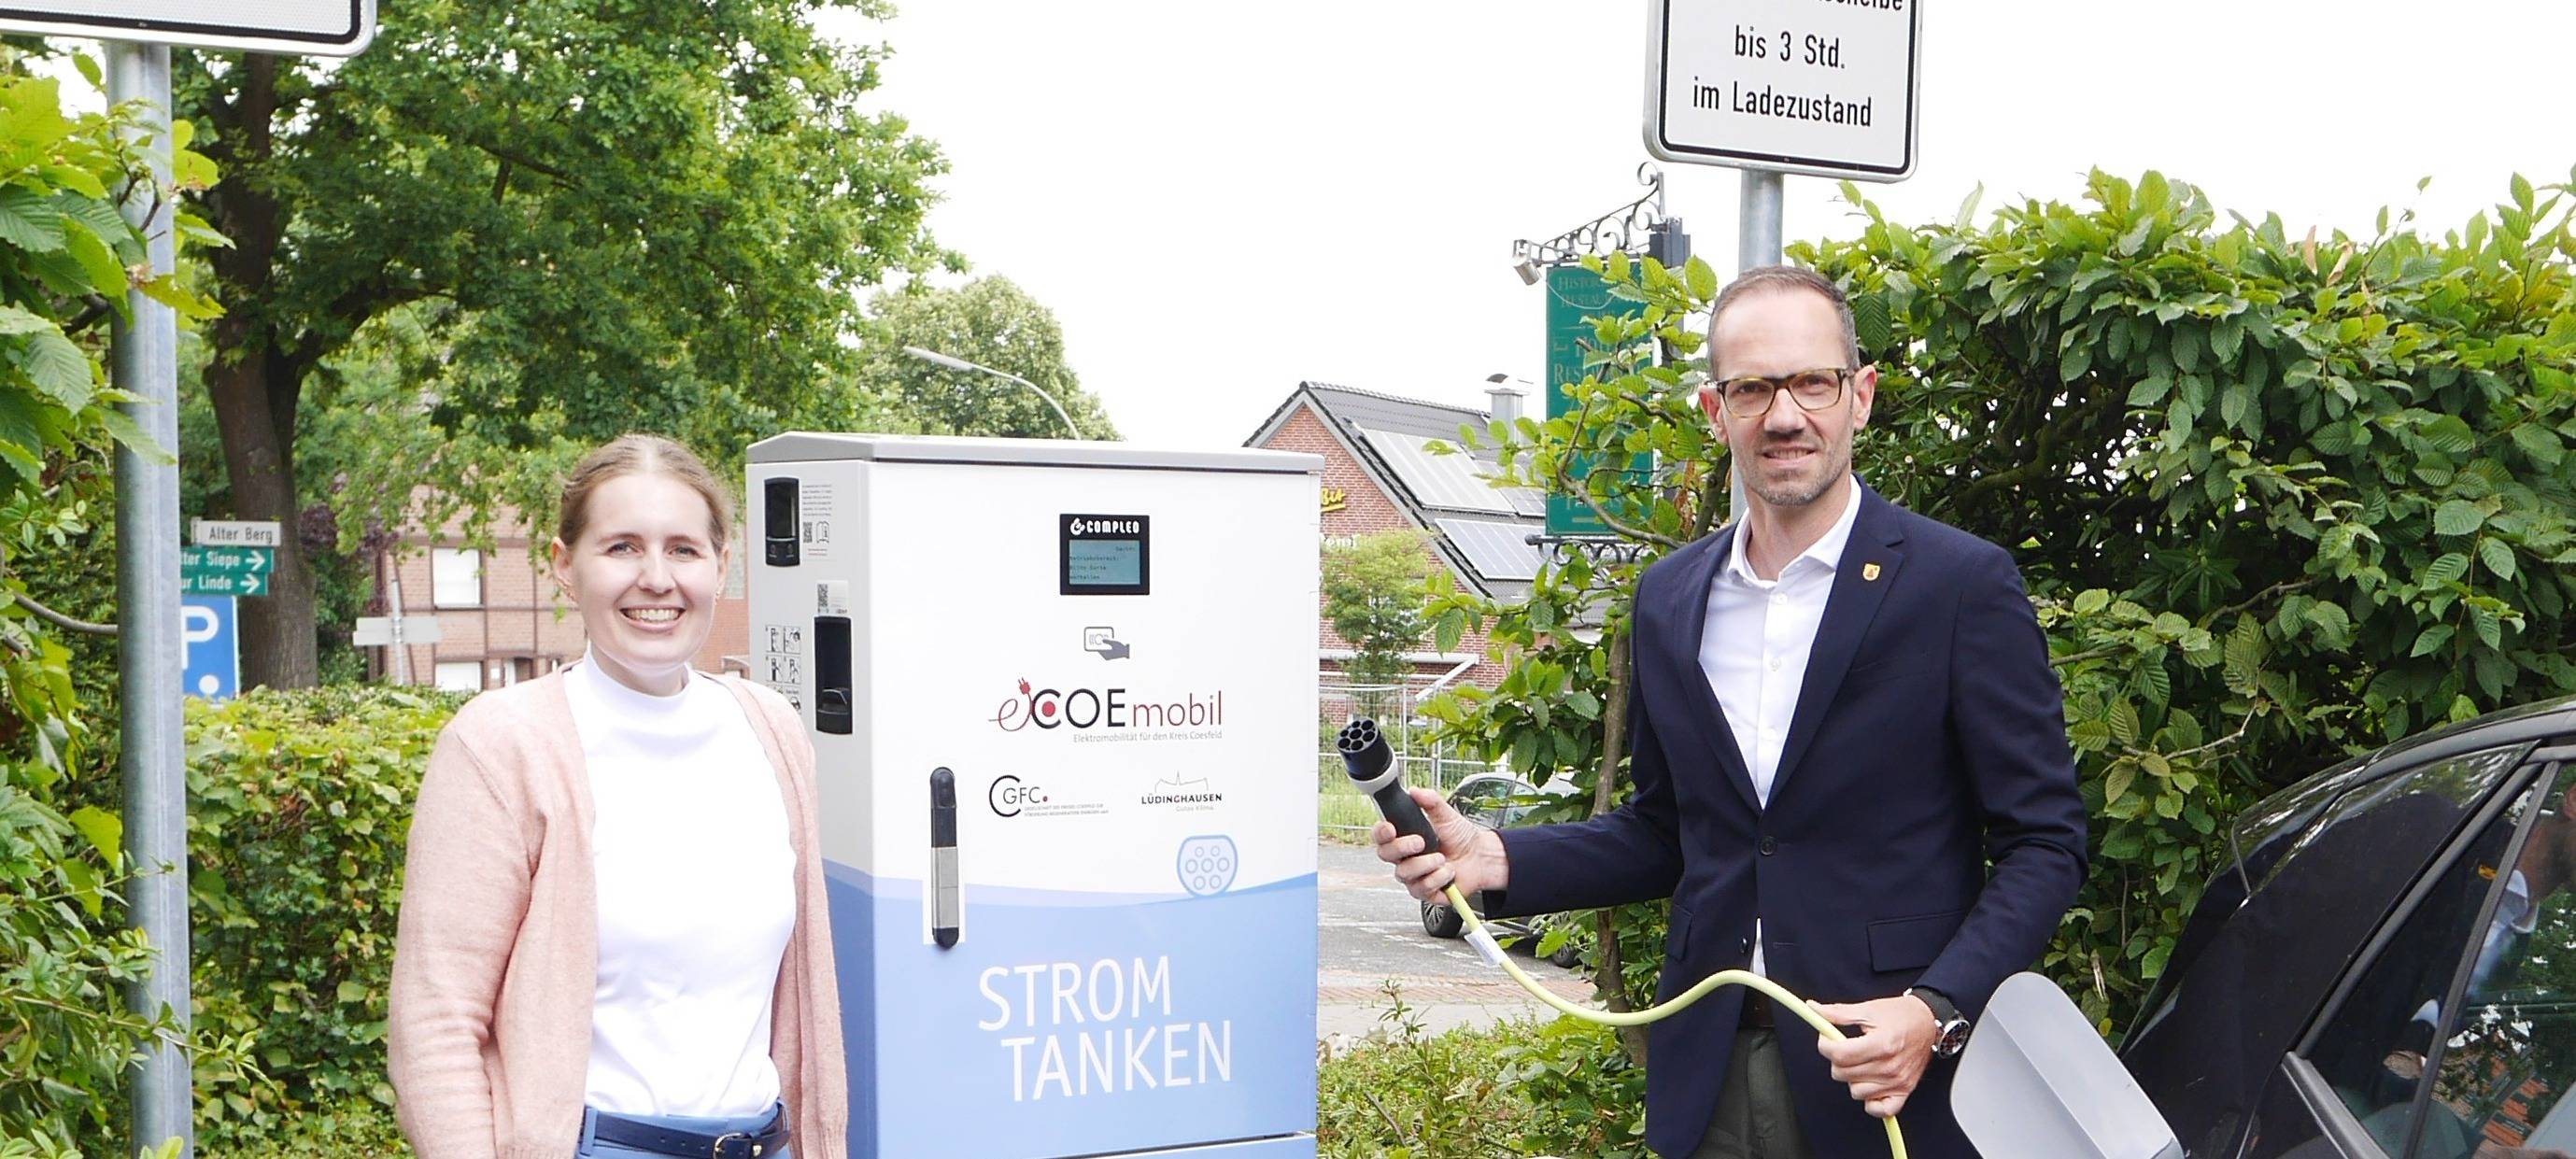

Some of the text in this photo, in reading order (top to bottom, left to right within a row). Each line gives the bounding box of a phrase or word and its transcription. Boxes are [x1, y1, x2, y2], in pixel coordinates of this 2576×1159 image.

[1734, 24, 1846, 69] bis 3 Std.
[1692, 76, 1872, 127] im Ladezustand
[209, 526, 273, 544] Alter Berg
[1086, 520, 1139, 533] COMPLEO
[206, 551, 240, 570] Siepe
[181, 575, 232, 590] ur Linde
[181, 606, 220, 671] P
[1073, 730, 1223, 743] Elektromobilität für den Kreis Coesfeld
[1141, 793, 1223, 805] LÜDINGHAUSEN
[979, 955, 1171, 1031] STROM
[1000, 1020, 1231, 1102] TANKEN
